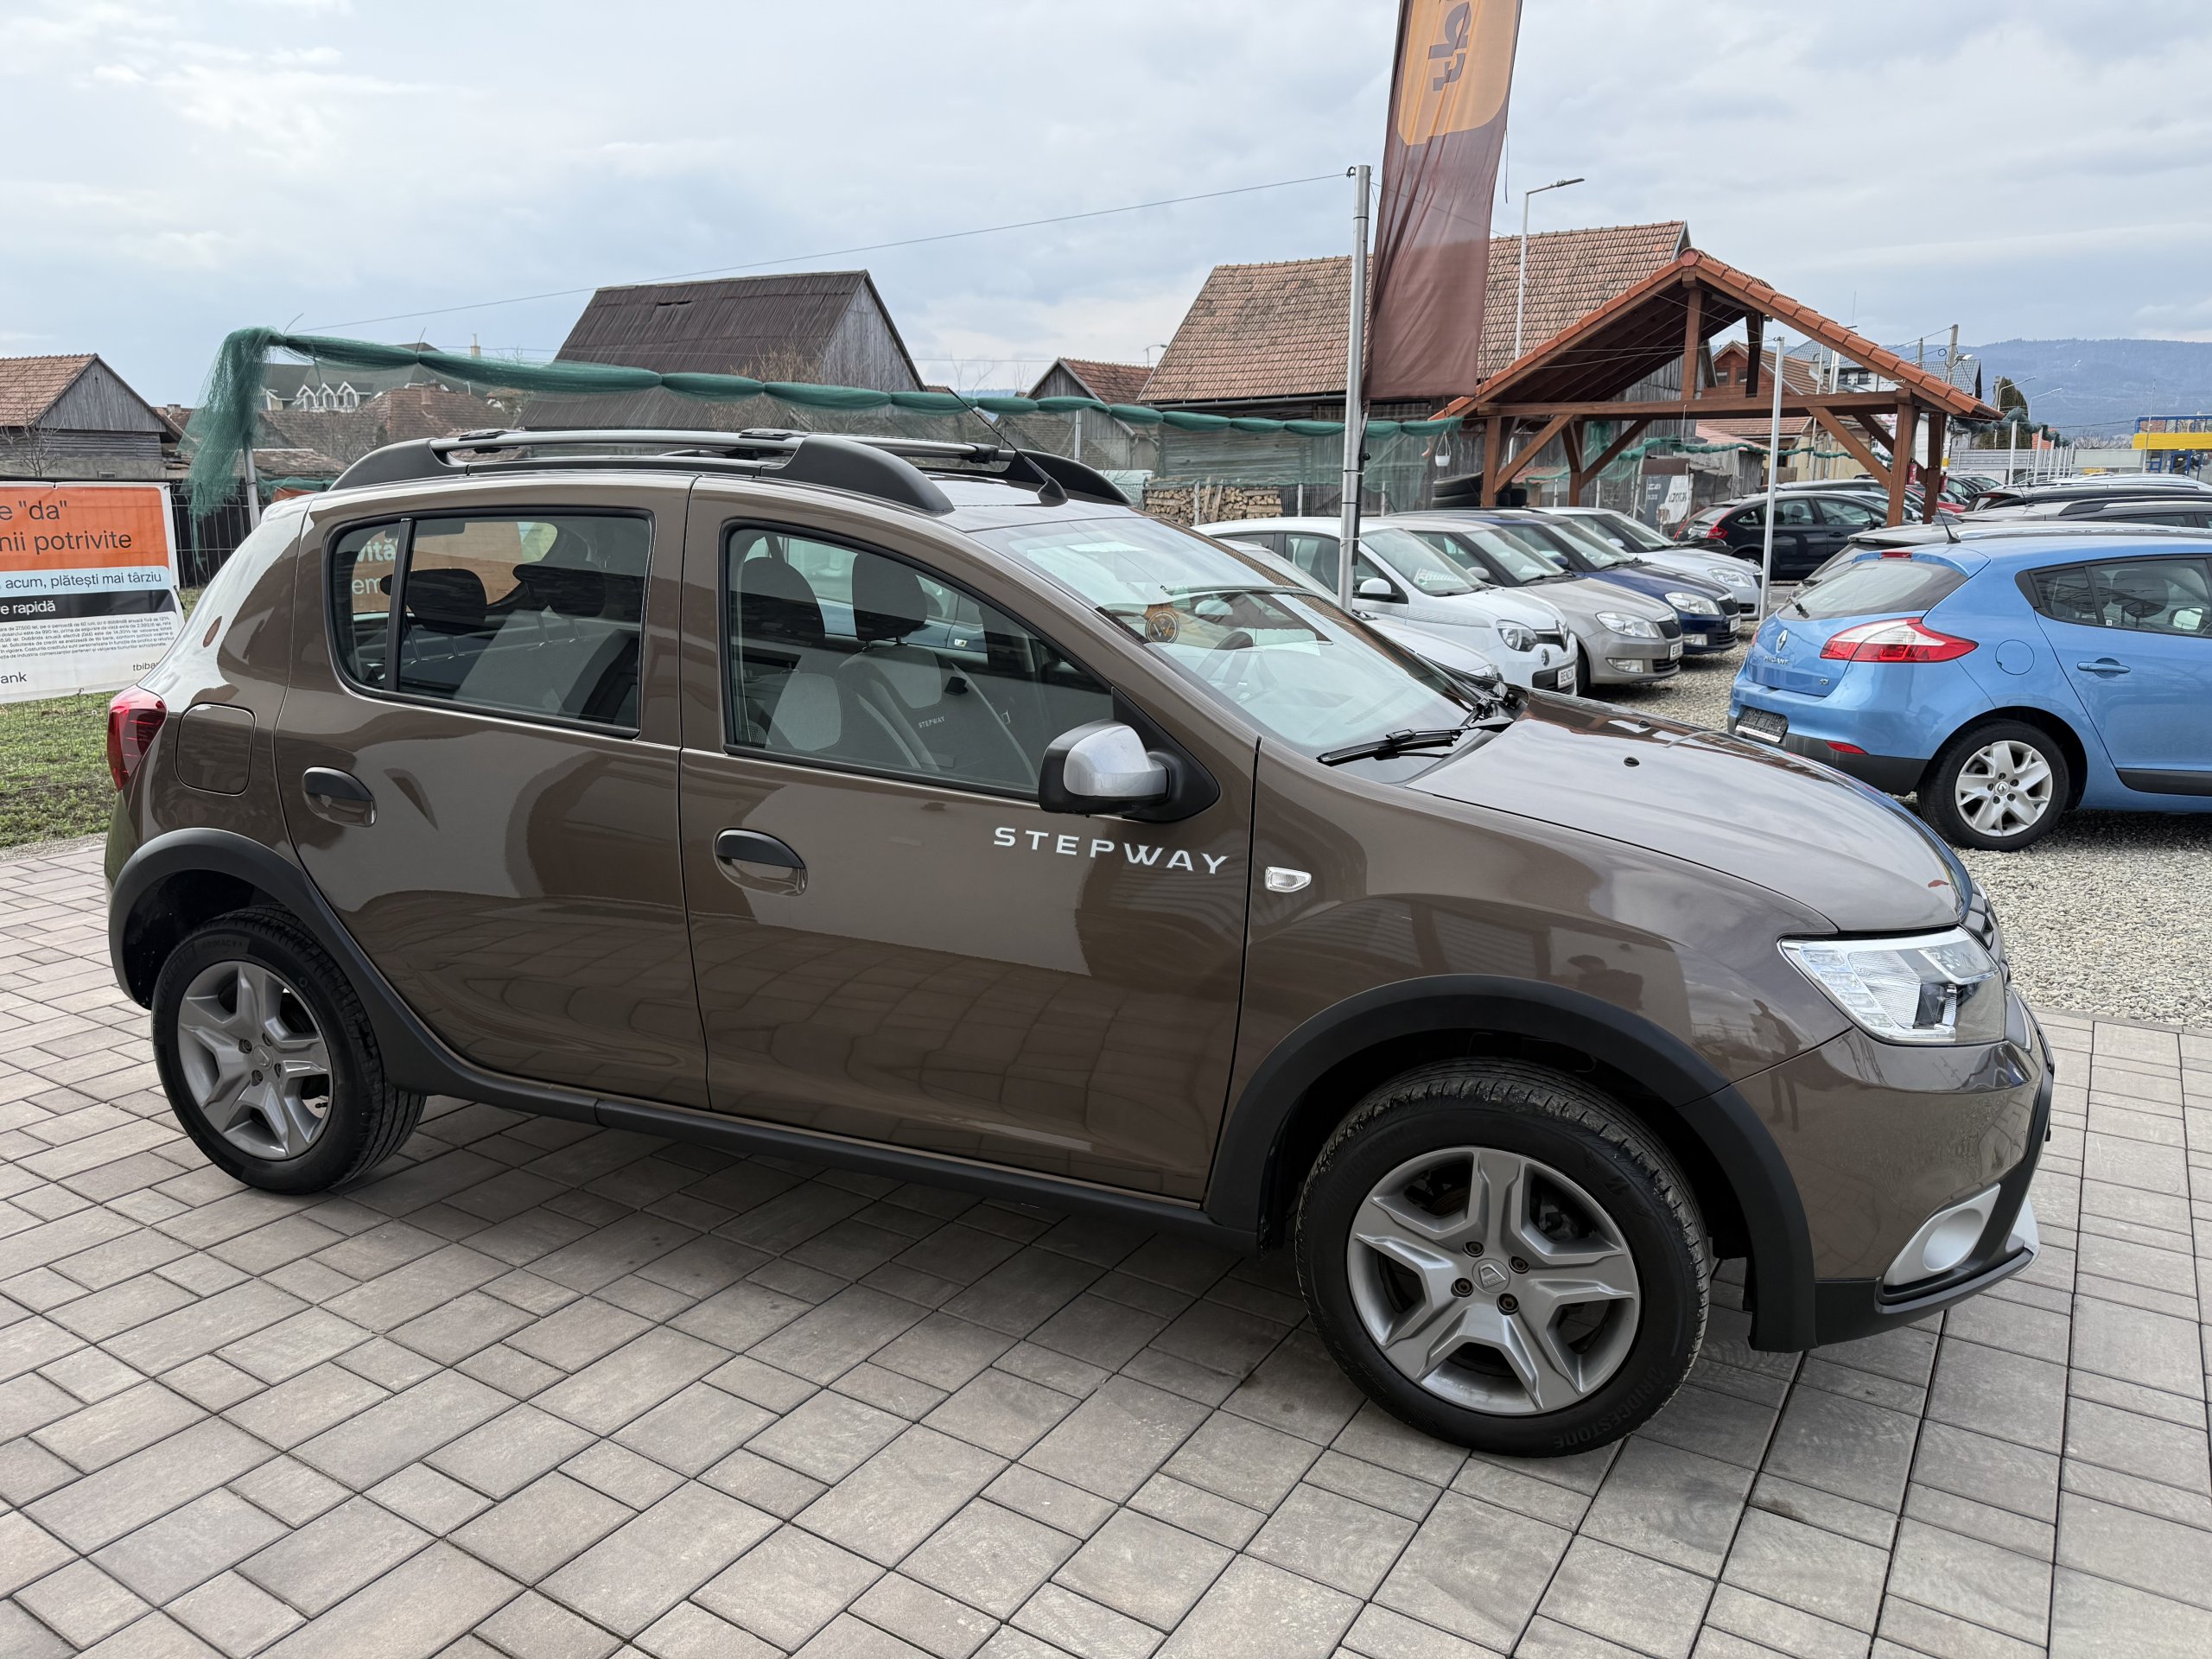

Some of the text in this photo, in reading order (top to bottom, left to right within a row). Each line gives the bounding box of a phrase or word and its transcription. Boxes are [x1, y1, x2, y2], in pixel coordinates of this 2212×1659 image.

[1428, 0, 1471, 92] tb
[19, 500, 67, 520] "da"
[35, 531, 131, 555] potrivite
[5, 571, 162, 590] acum, plătești mai târziu
[0, 600, 56, 615] e rapidă
[133, 661, 159, 671] tbiba
[0, 671, 27, 684] ank
[918, 715, 945, 728] STEPWAY
[994, 827, 1229, 874] STEPWAY
